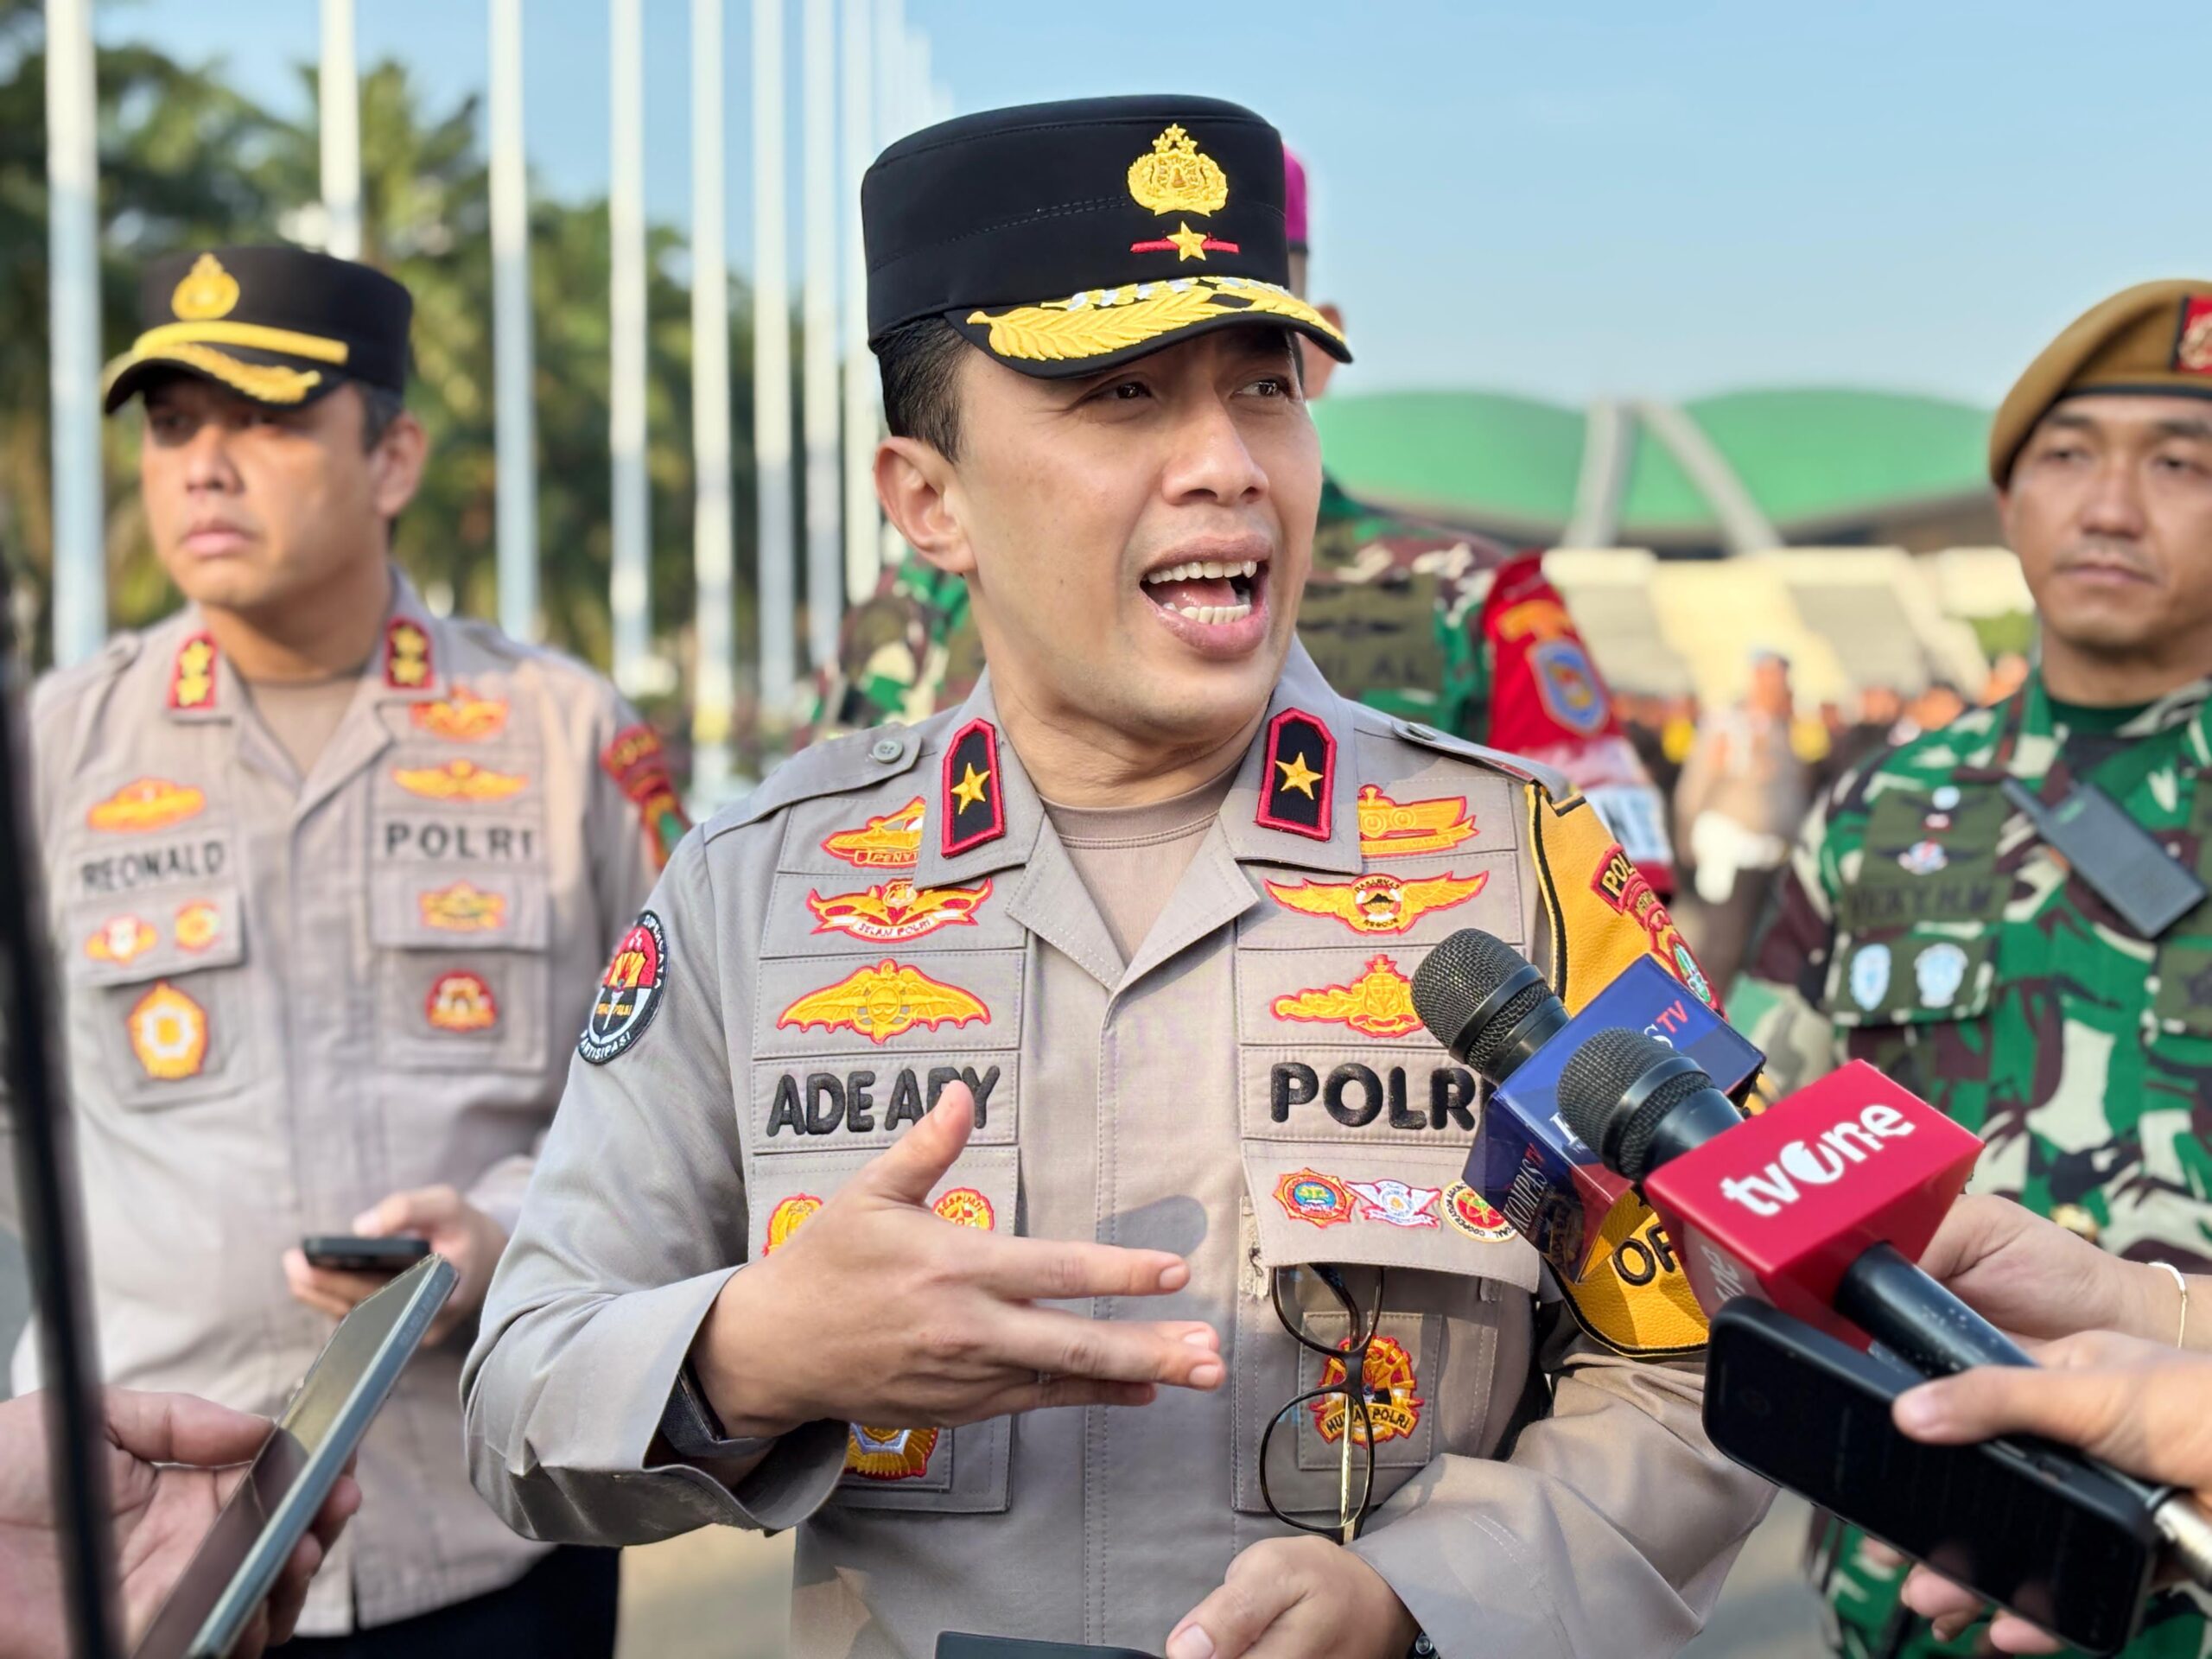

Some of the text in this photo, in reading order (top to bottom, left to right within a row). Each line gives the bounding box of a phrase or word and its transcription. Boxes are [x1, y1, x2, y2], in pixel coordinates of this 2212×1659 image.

[384, 822, 534, 861] POLRI
[1656, 1000, 1688, 1034] TV
[766, 1071, 876, 1137] ADE
[1719, 1104, 1916, 1217] tvOne
[1503, 1159, 1548, 1234] KOMPAS
[1371, 1408, 1411, 1429] POLRI
